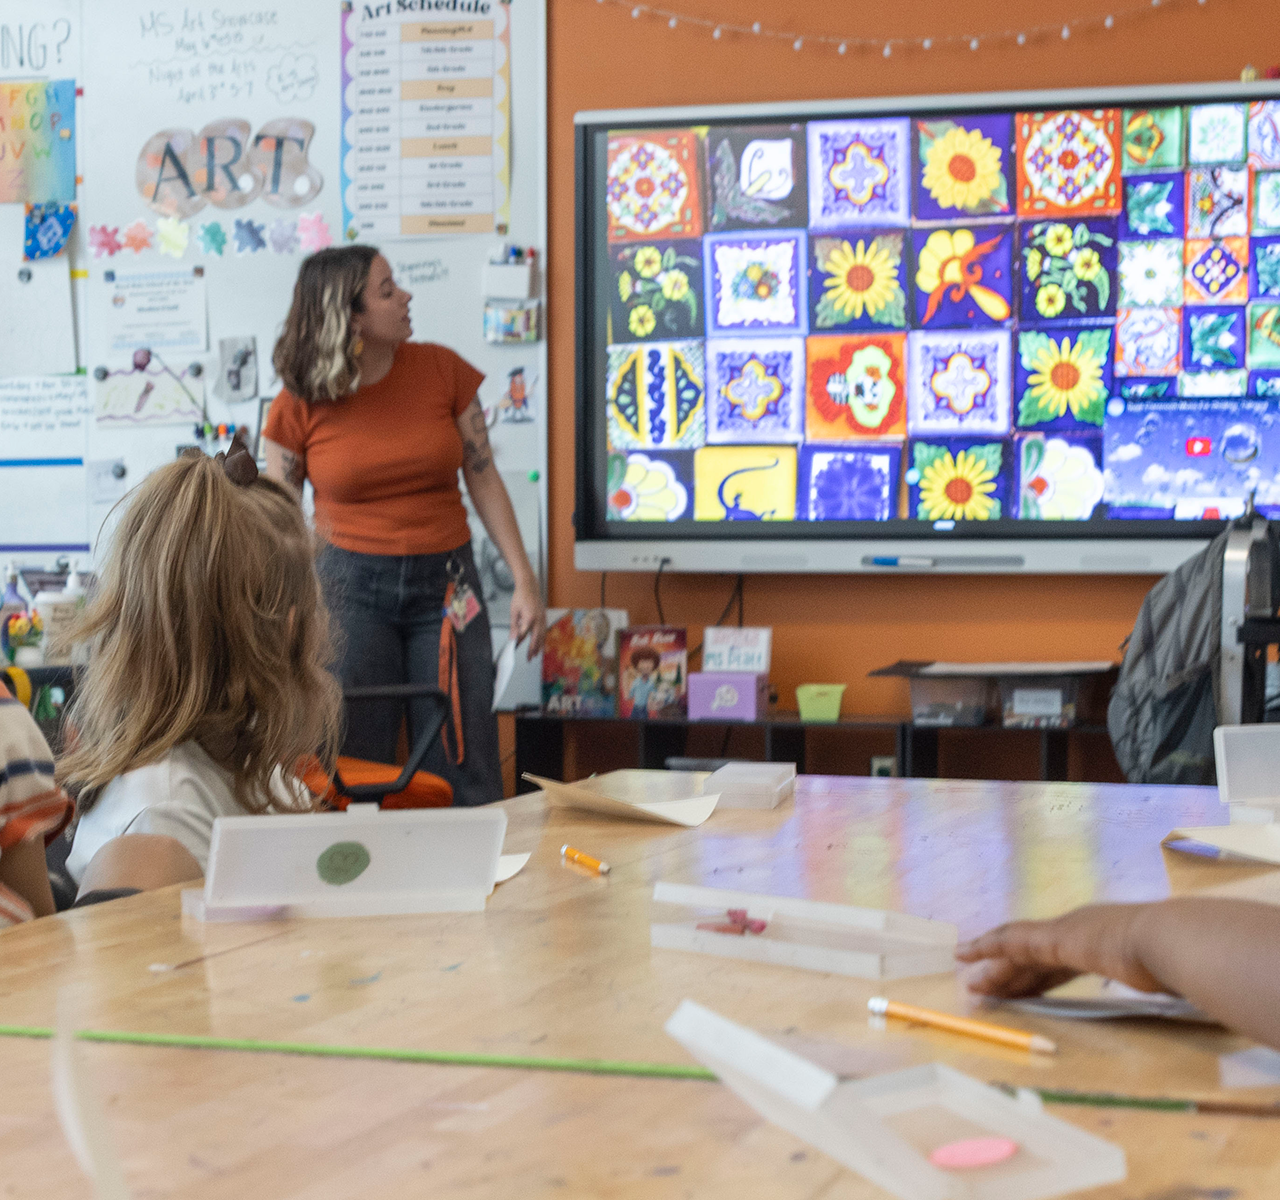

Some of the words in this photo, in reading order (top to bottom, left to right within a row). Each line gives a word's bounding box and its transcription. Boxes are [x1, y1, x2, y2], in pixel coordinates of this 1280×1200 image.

[361, 3, 391, 21] Art
[9, 89, 21, 108] F
[29, 112, 44, 132] O
[50, 112, 63, 132] P
[10, 140, 26, 160] V
[32, 142, 52, 160] W
[152, 133, 306, 202] ART
[547, 694, 582, 711] ART
